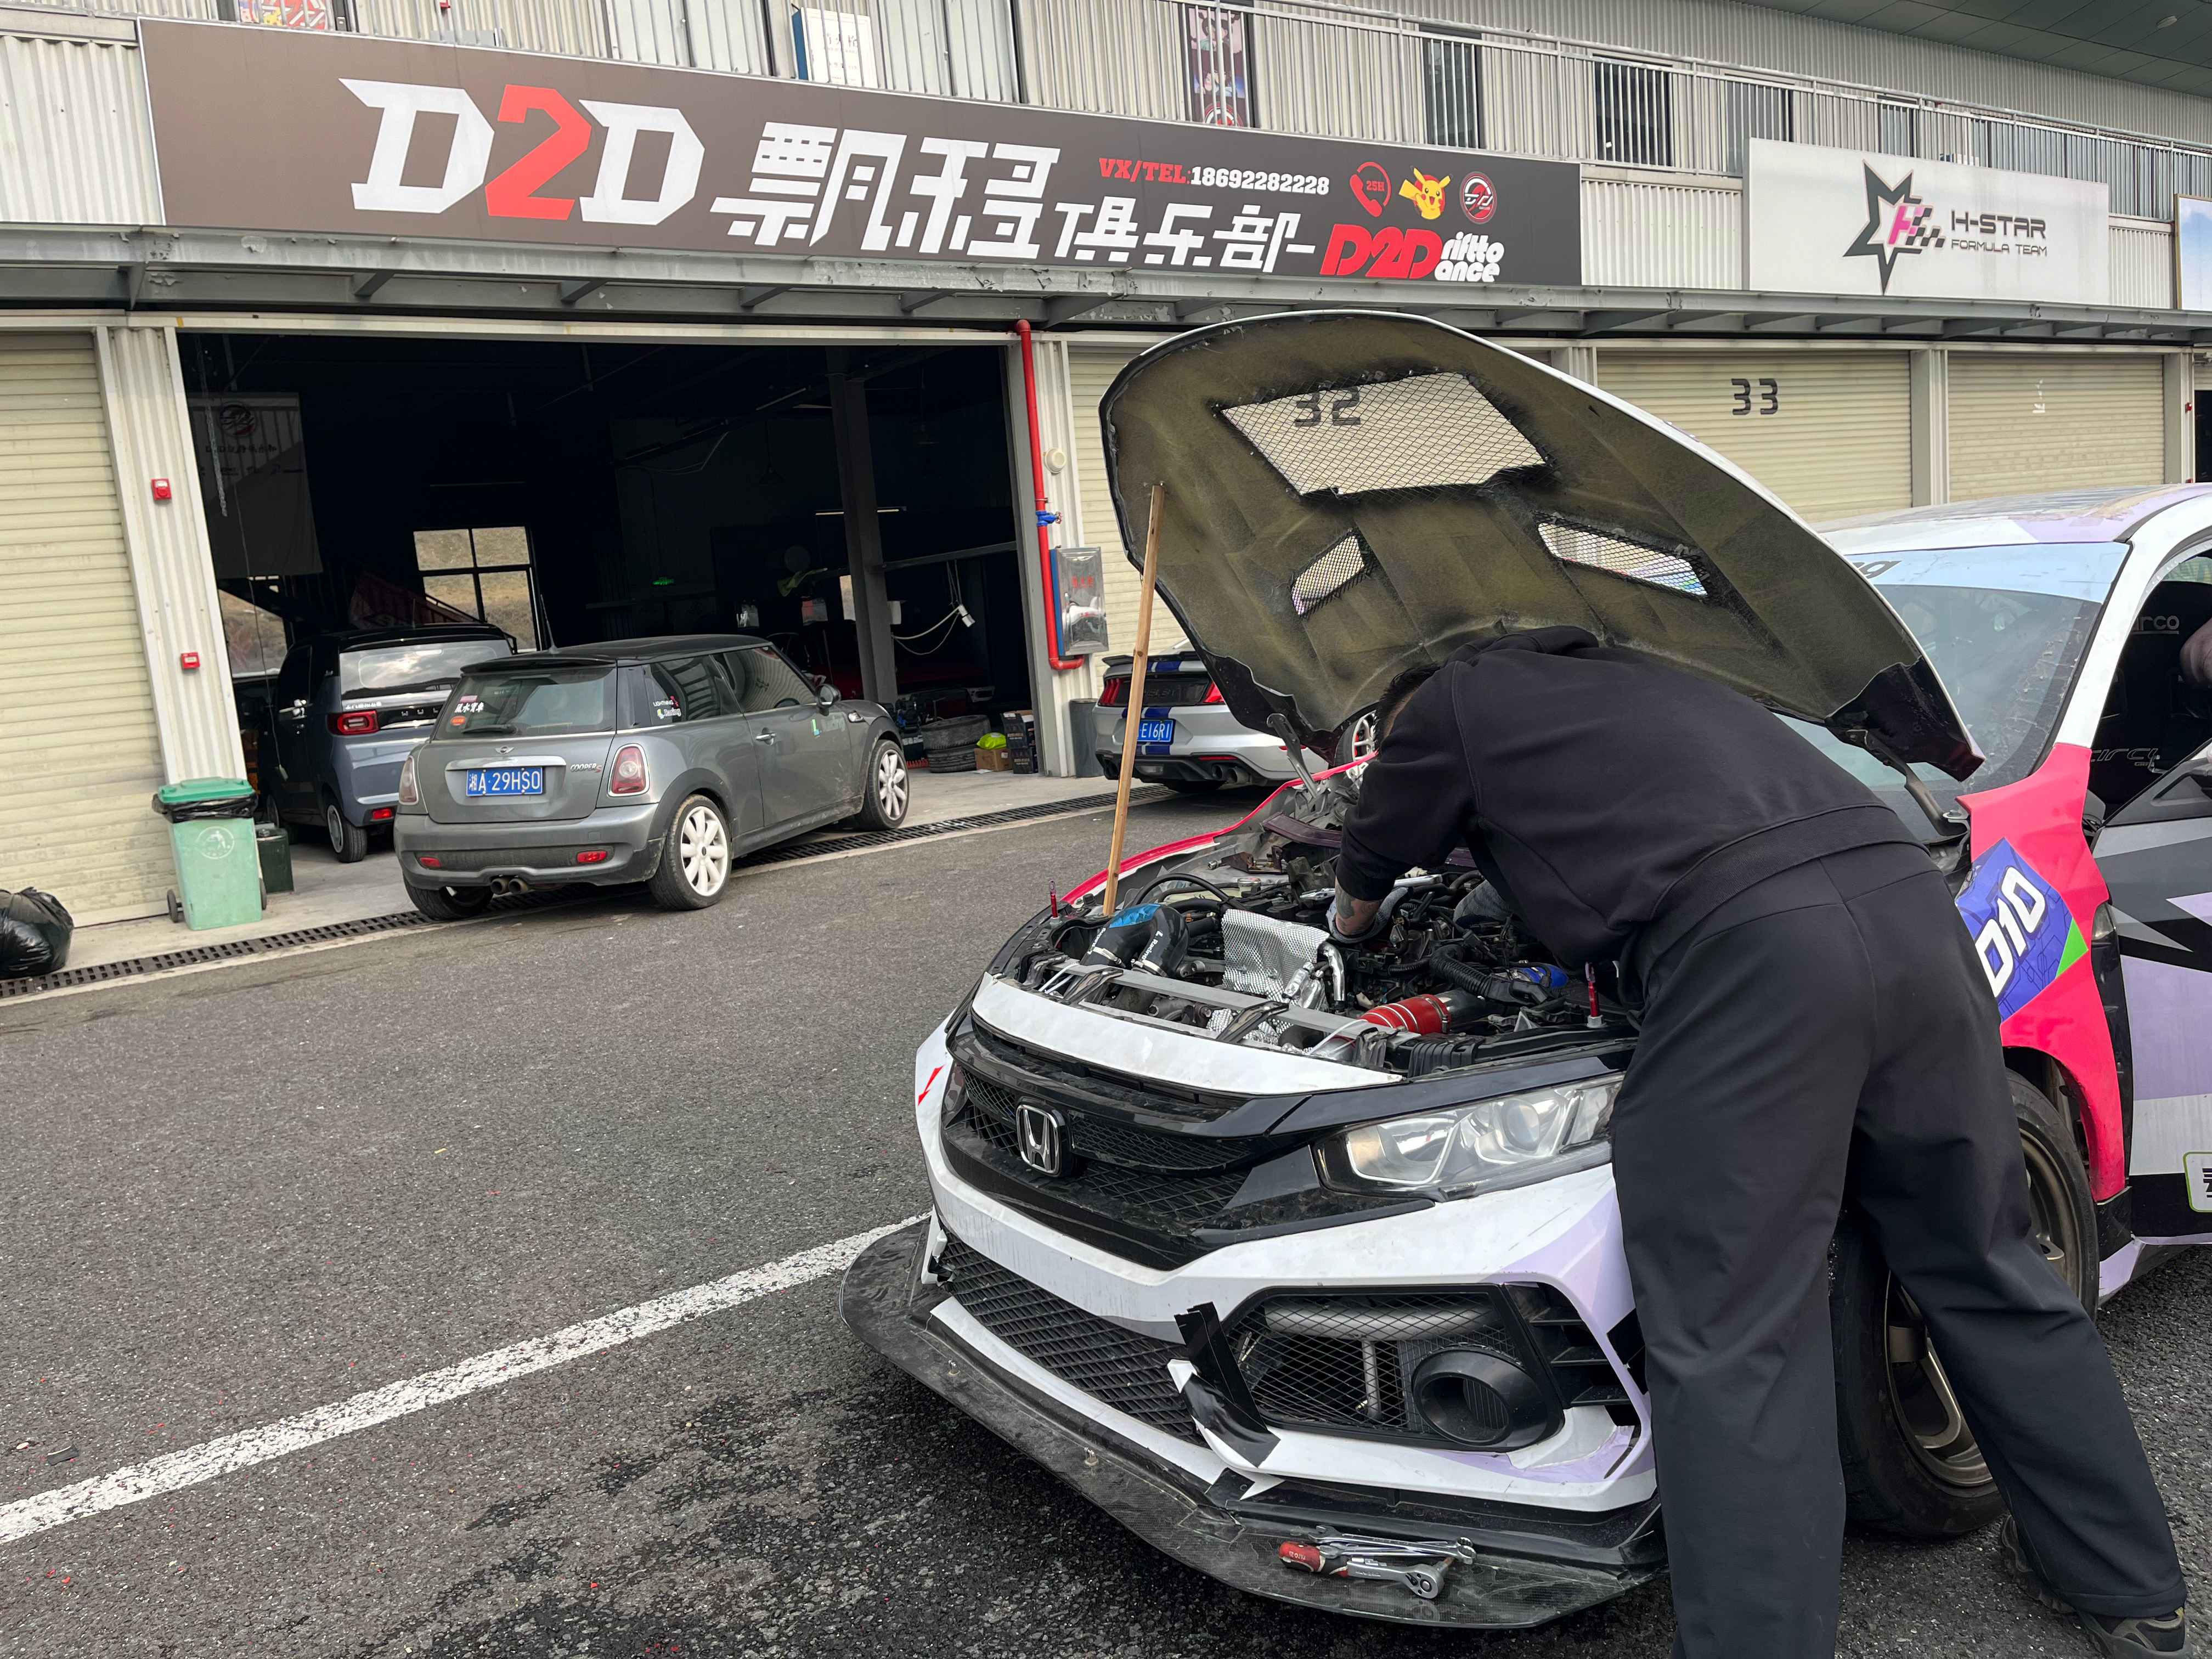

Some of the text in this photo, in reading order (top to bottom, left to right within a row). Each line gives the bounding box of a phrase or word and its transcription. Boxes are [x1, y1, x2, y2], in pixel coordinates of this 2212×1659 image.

[338, 78, 706, 226] D2D
[1366, 180, 1385, 192] 25H
[1951, 208, 2046, 239] H-STAR
[1319, 223, 1444, 279] D2D
[1951, 239, 2048, 257] FORMULA TEAM
[1294, 385, 1361, 427] 32
[1731, 378, 1779, 415] 33
[1137, 723, 1171, 740] ·E16R1
[570, 763, 602, 773] COOPER S
